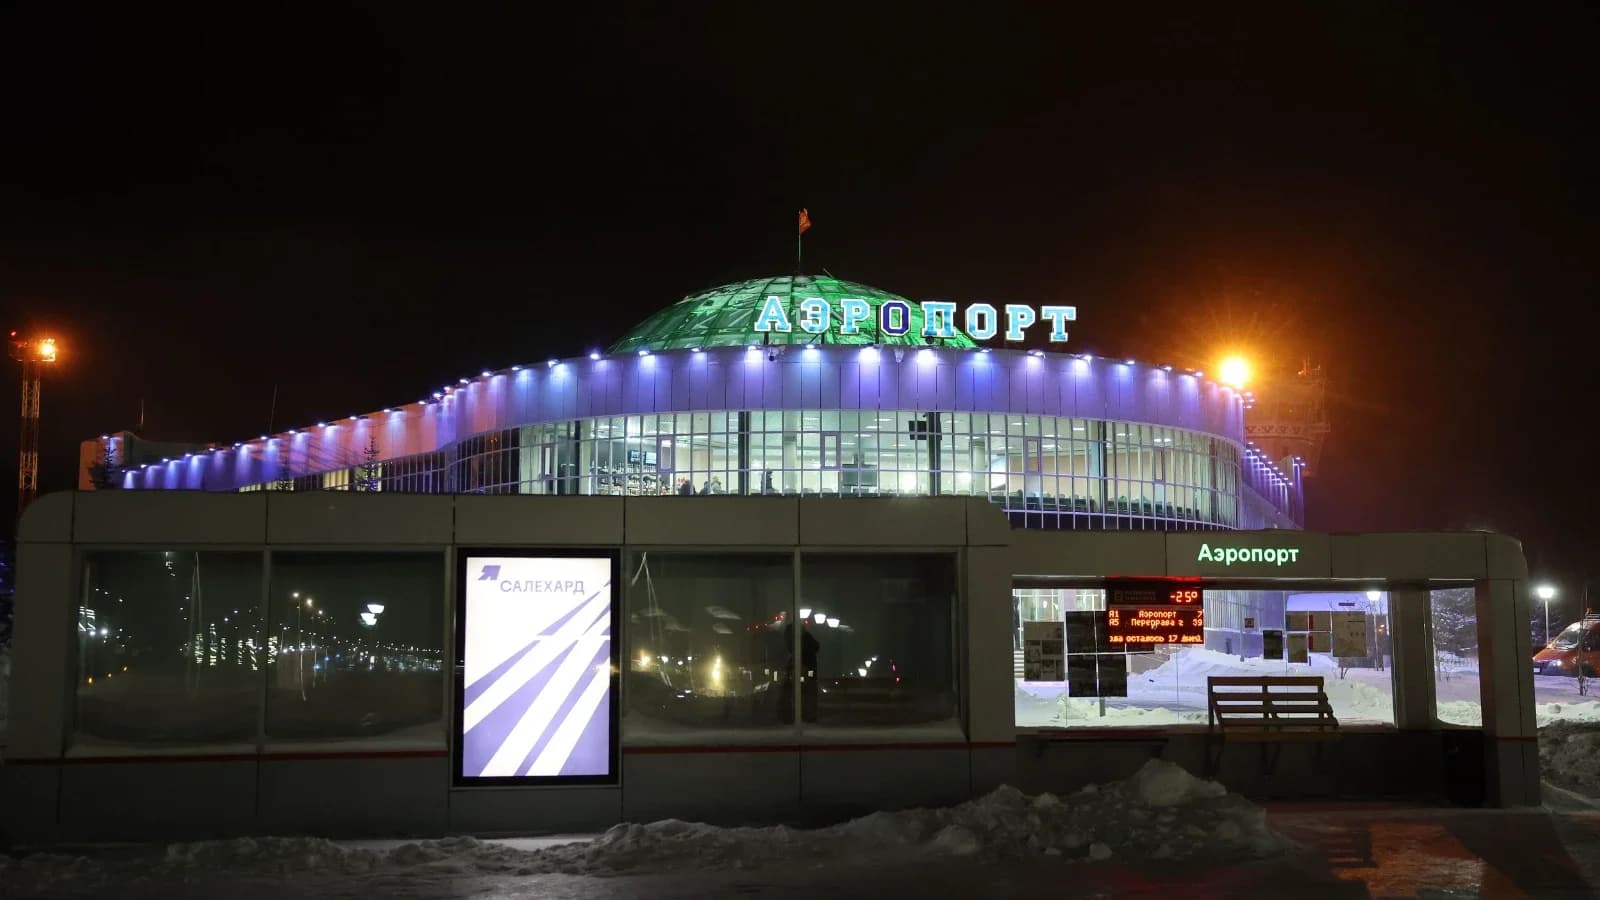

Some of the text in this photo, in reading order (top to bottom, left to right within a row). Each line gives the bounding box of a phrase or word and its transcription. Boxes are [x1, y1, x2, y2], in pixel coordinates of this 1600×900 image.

[754, 295, 1077, 343] АЭРОПОРТ
[1198, 543, 1299, 566] Аэропорт
[500, 580, 585, 595] САЛЕХАРД
[1138, 610, 1177, 619] Аэропорт
[1168, 634, 1178, 642] 17
